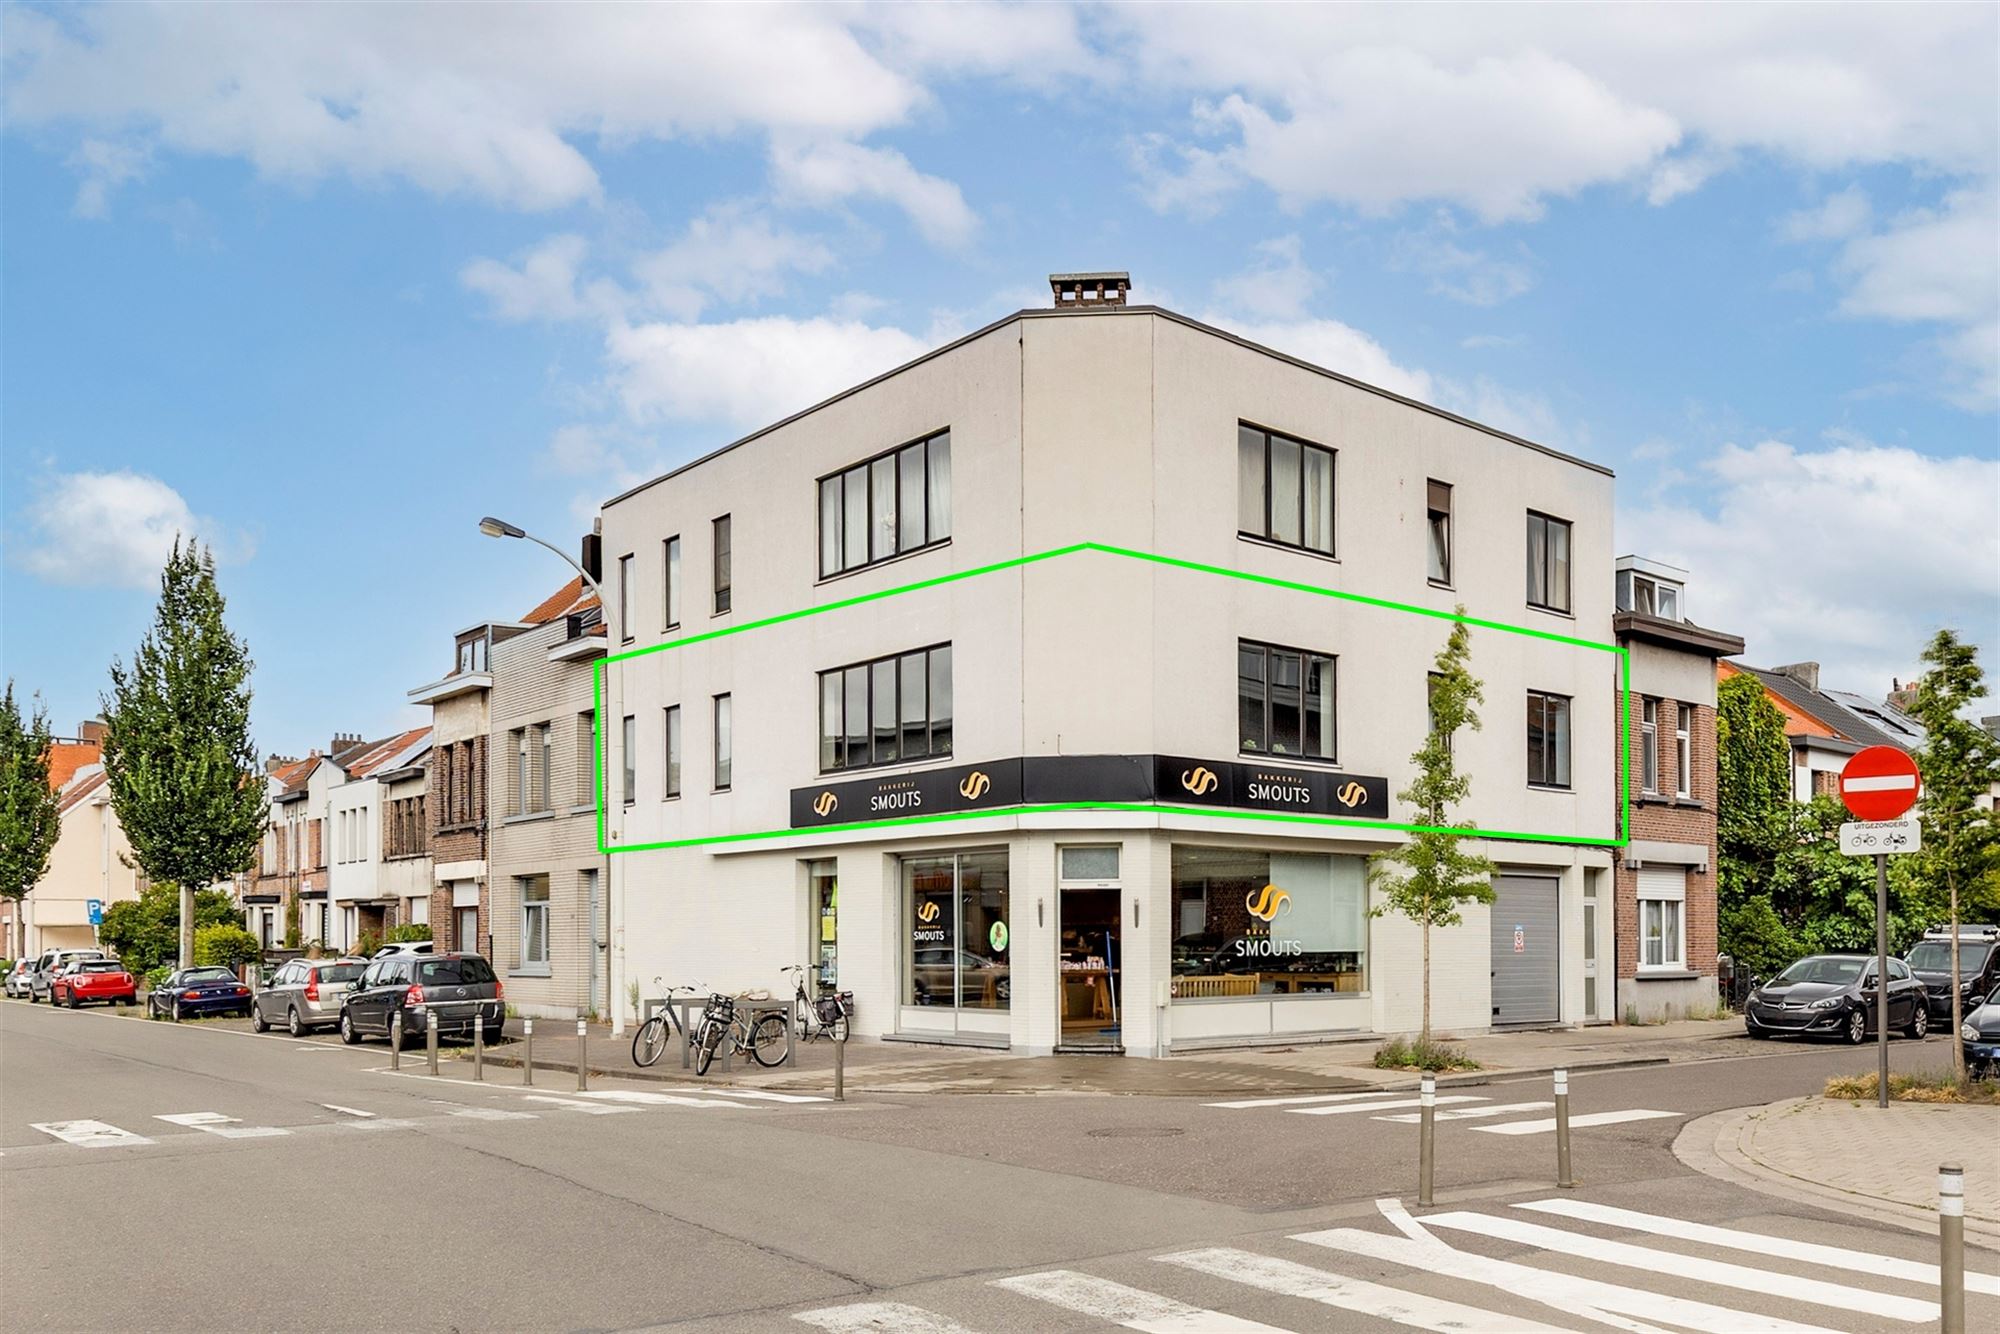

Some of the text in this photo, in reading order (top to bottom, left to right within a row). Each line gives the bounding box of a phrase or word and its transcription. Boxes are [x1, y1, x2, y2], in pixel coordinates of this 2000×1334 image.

[871, 790, 921, 811] SMOUTS
[1248, 783, 1311, 804] SMOUTS
[1854, 821, 1909, 830] UITGEZONDERD
[89, 901, 100, 916] P
[913, 930, 945, 941] SMOUTS
[1235, 939, 1302, 957] SMOUTS
